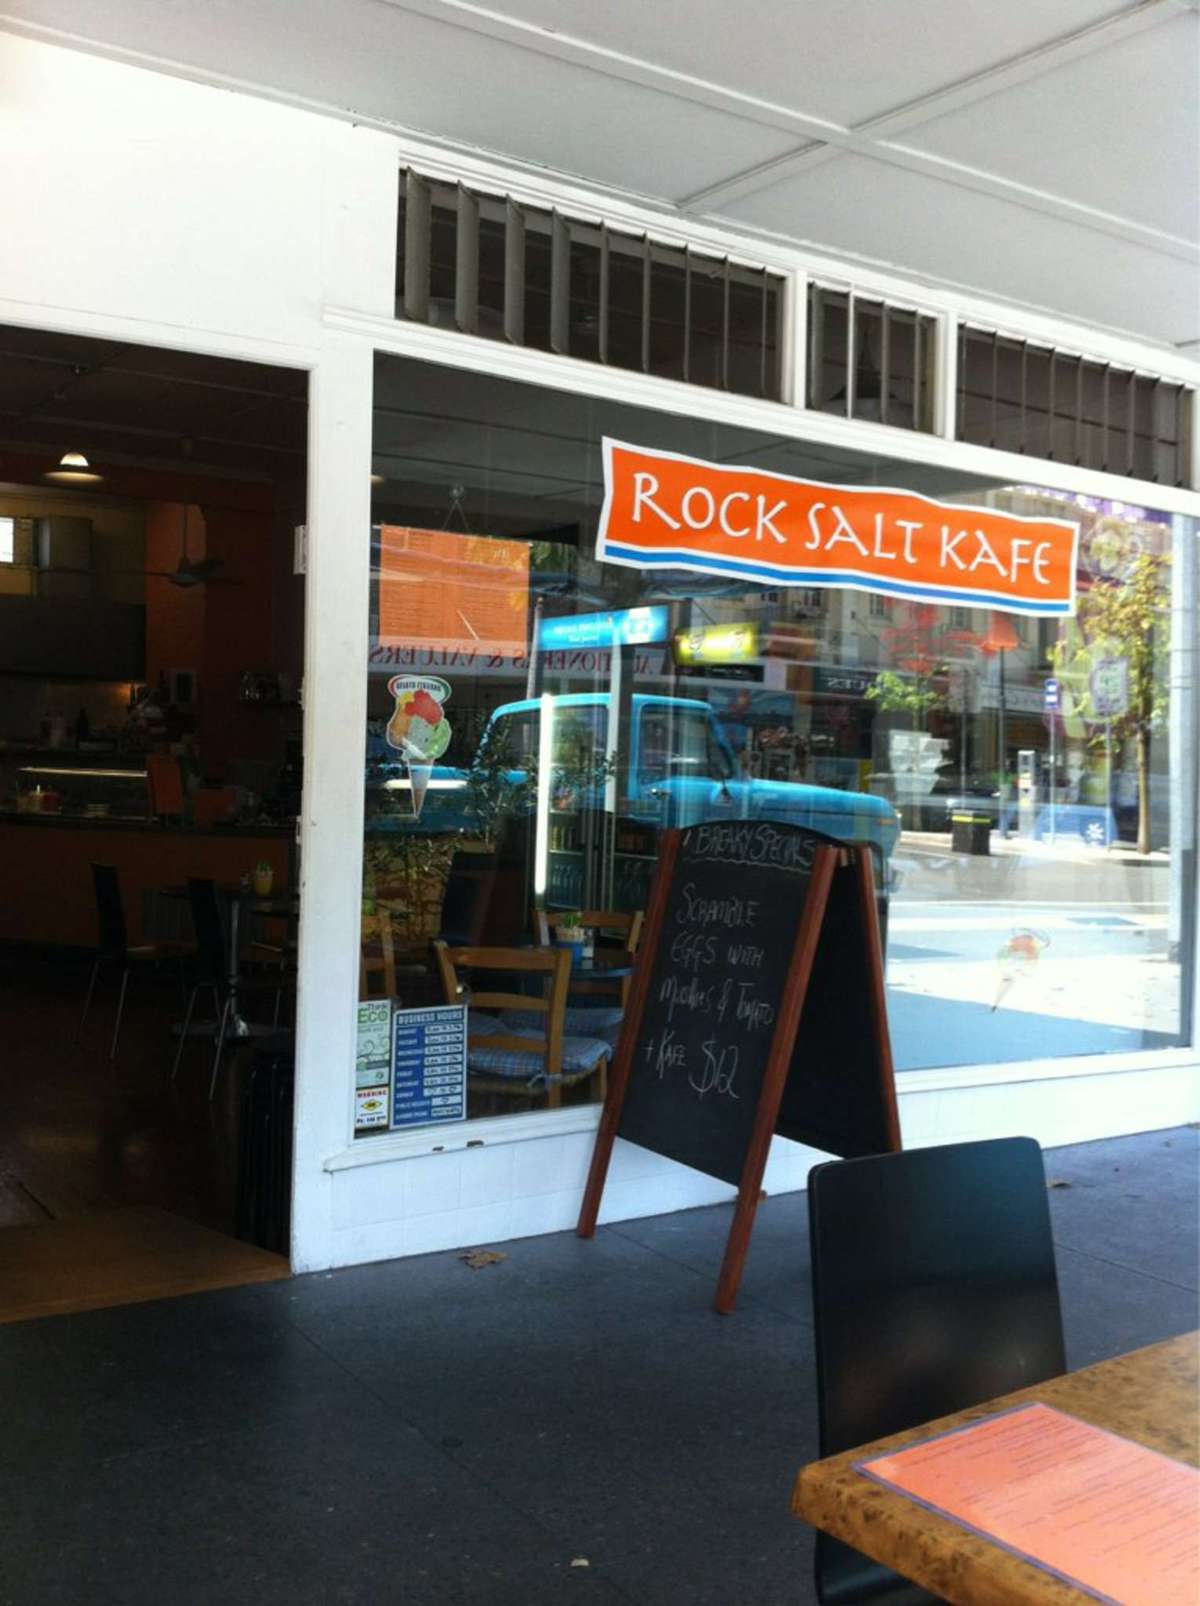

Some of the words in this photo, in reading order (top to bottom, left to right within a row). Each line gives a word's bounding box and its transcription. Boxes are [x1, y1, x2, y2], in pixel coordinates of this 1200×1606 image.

[631, 471, 788, 545] ROCK
[804, 501, 924, 565] SALT
[938, 524, 1053, 586] KAFE
